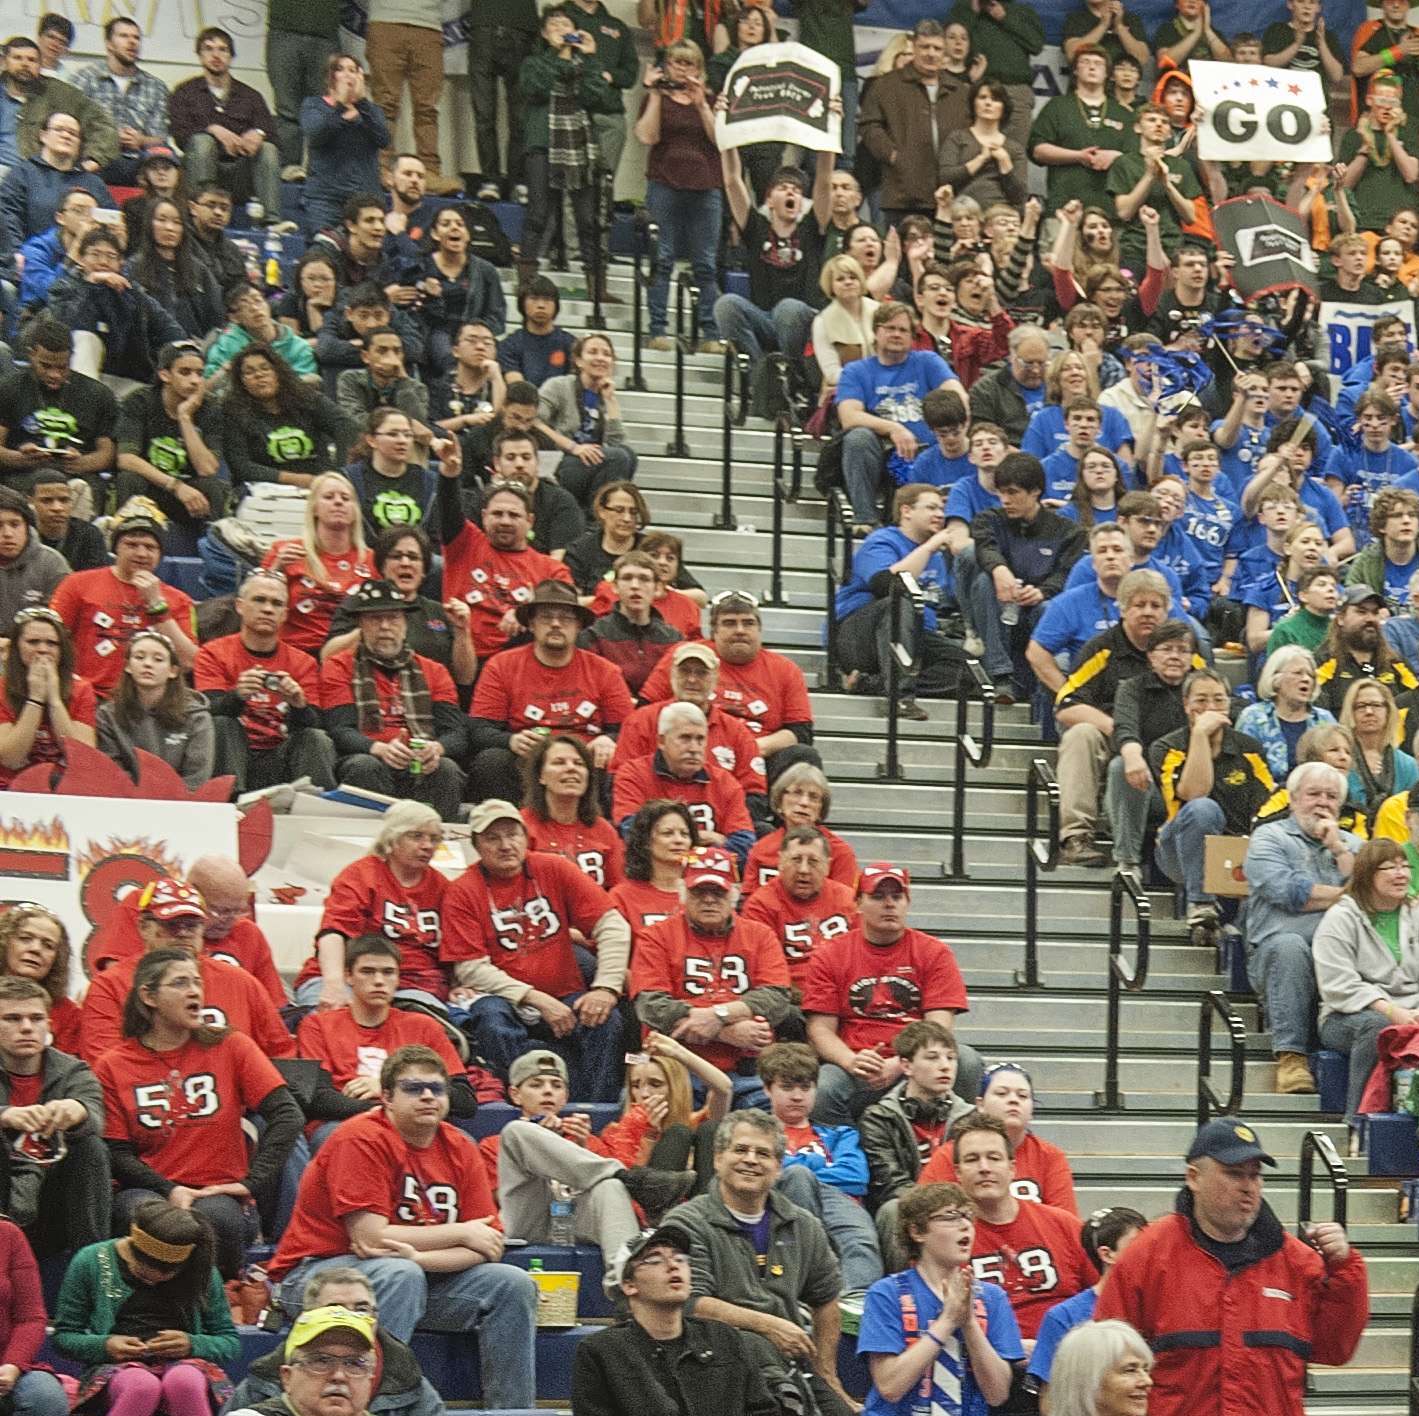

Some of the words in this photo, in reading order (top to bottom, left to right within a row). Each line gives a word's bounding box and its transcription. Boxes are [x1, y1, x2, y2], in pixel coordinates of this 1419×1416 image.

[1213, 100, 1311, 145] GO
[1186, 517, 1220, 545] 166
[492, 895, 561, 950] 58
[134, 1072, 220, 1130] 58
[397, 1174, 460, 1227] 58
[971, 1247, 1060, 1294] 58
